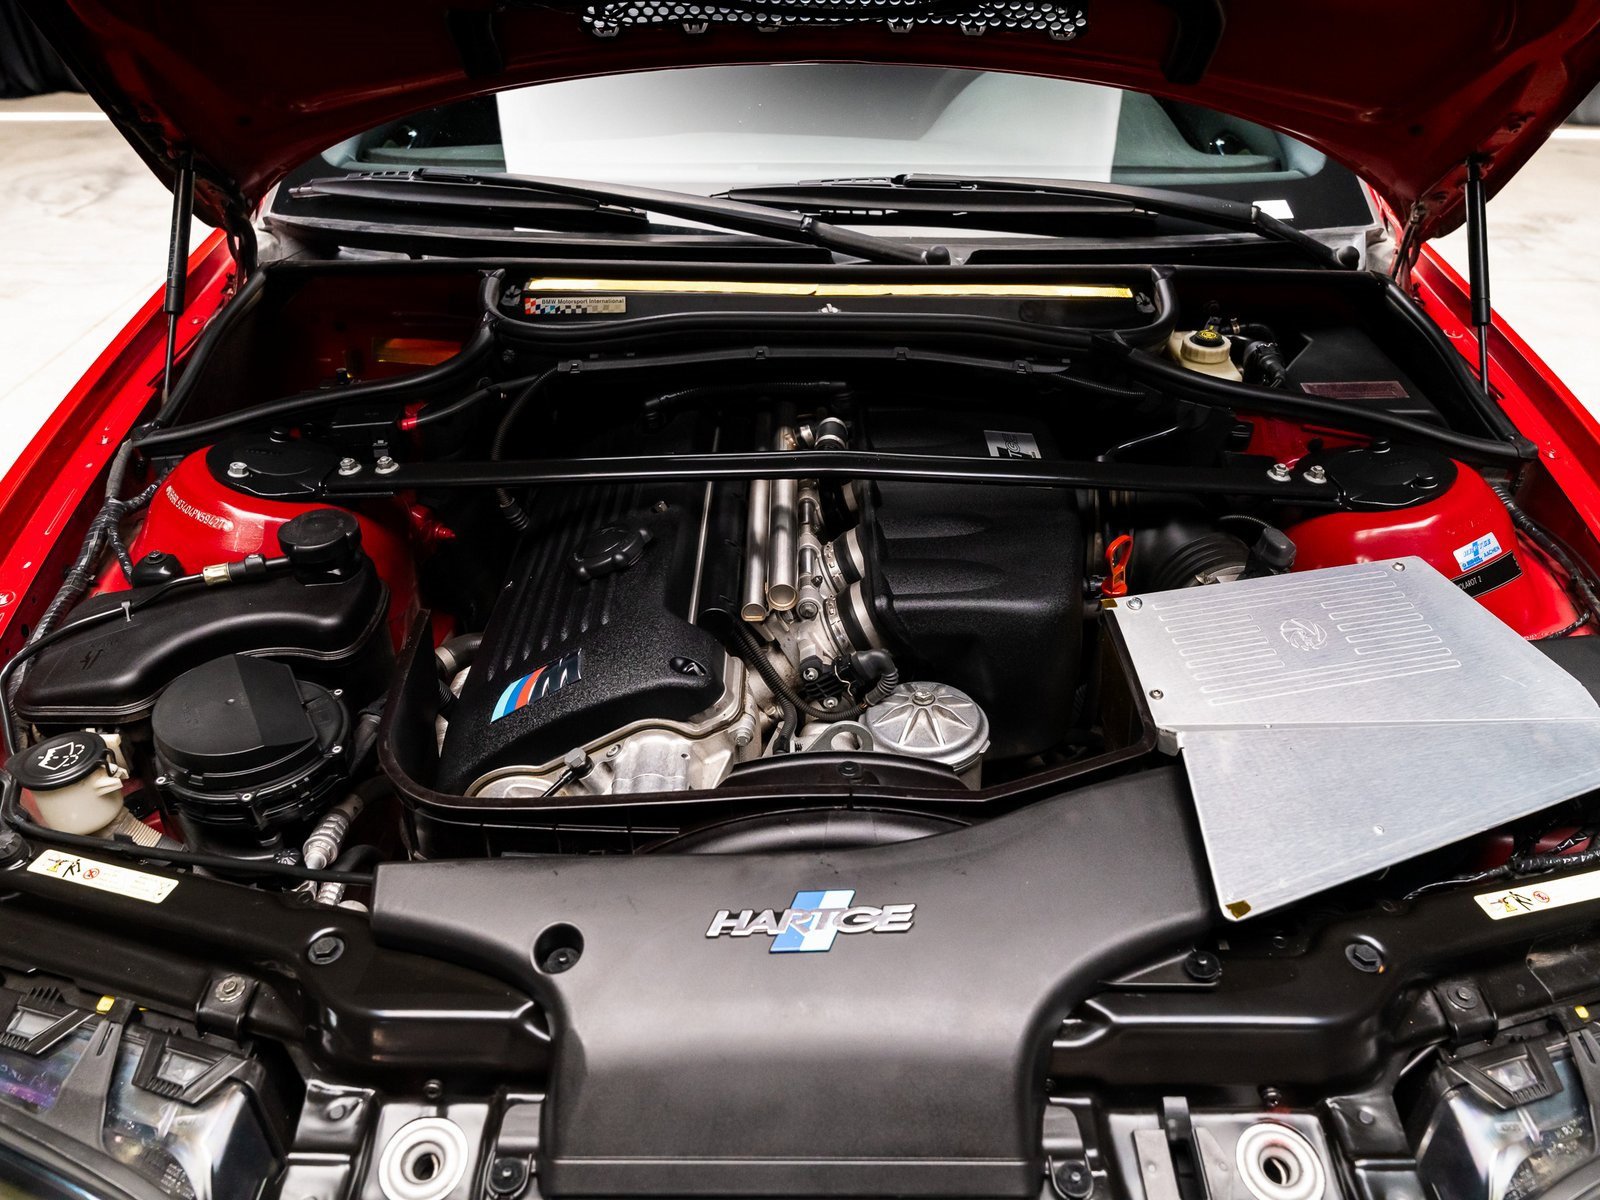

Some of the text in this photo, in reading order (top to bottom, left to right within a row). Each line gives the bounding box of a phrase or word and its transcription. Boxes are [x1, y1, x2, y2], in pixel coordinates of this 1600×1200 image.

[1483, 546, 1500, 558] AACHEN
[1458, 577, 1477, 590] OLAROT
[705, 903, 917, 938] HARTGE
